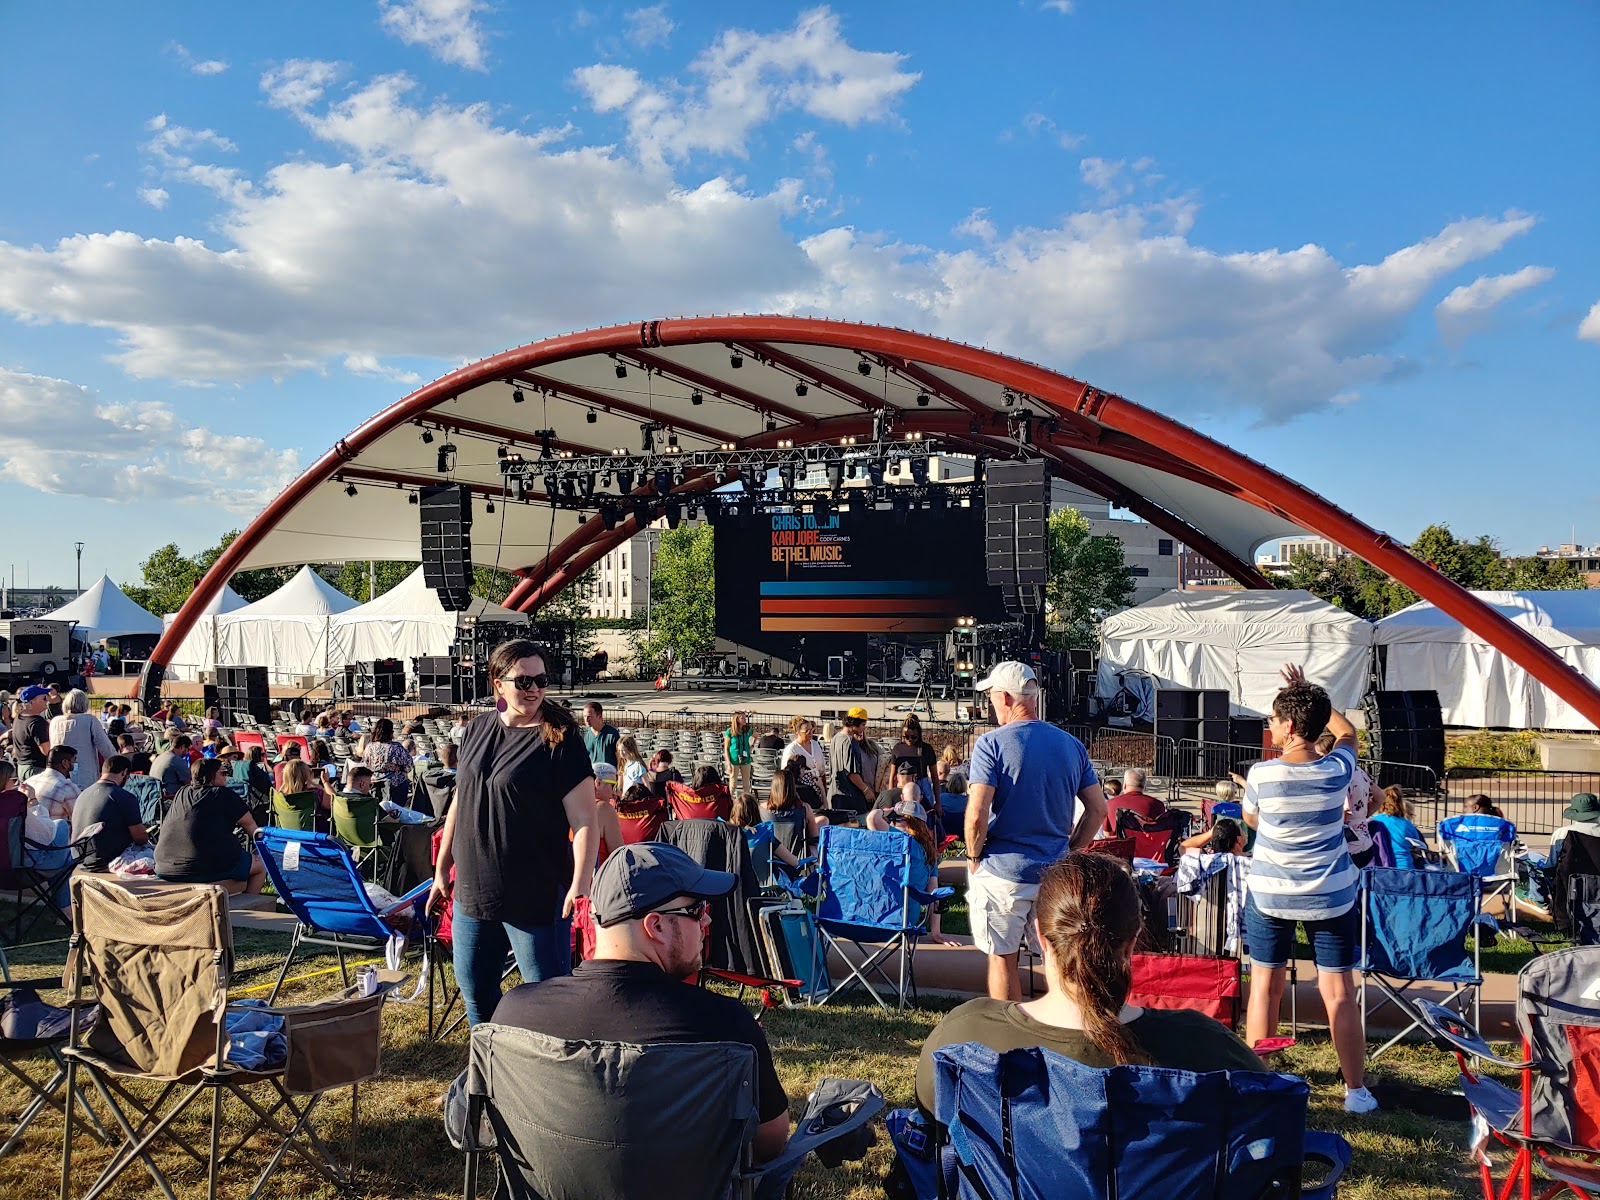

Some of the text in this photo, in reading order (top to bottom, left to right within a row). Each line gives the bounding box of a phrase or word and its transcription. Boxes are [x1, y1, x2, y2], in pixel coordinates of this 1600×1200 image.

[771, 514, 840, 530] CHRIS TOIN
[772, 530, 820, 546] KARI JOBE
[771, 545, 842, 562] BETHEL MUSIC
